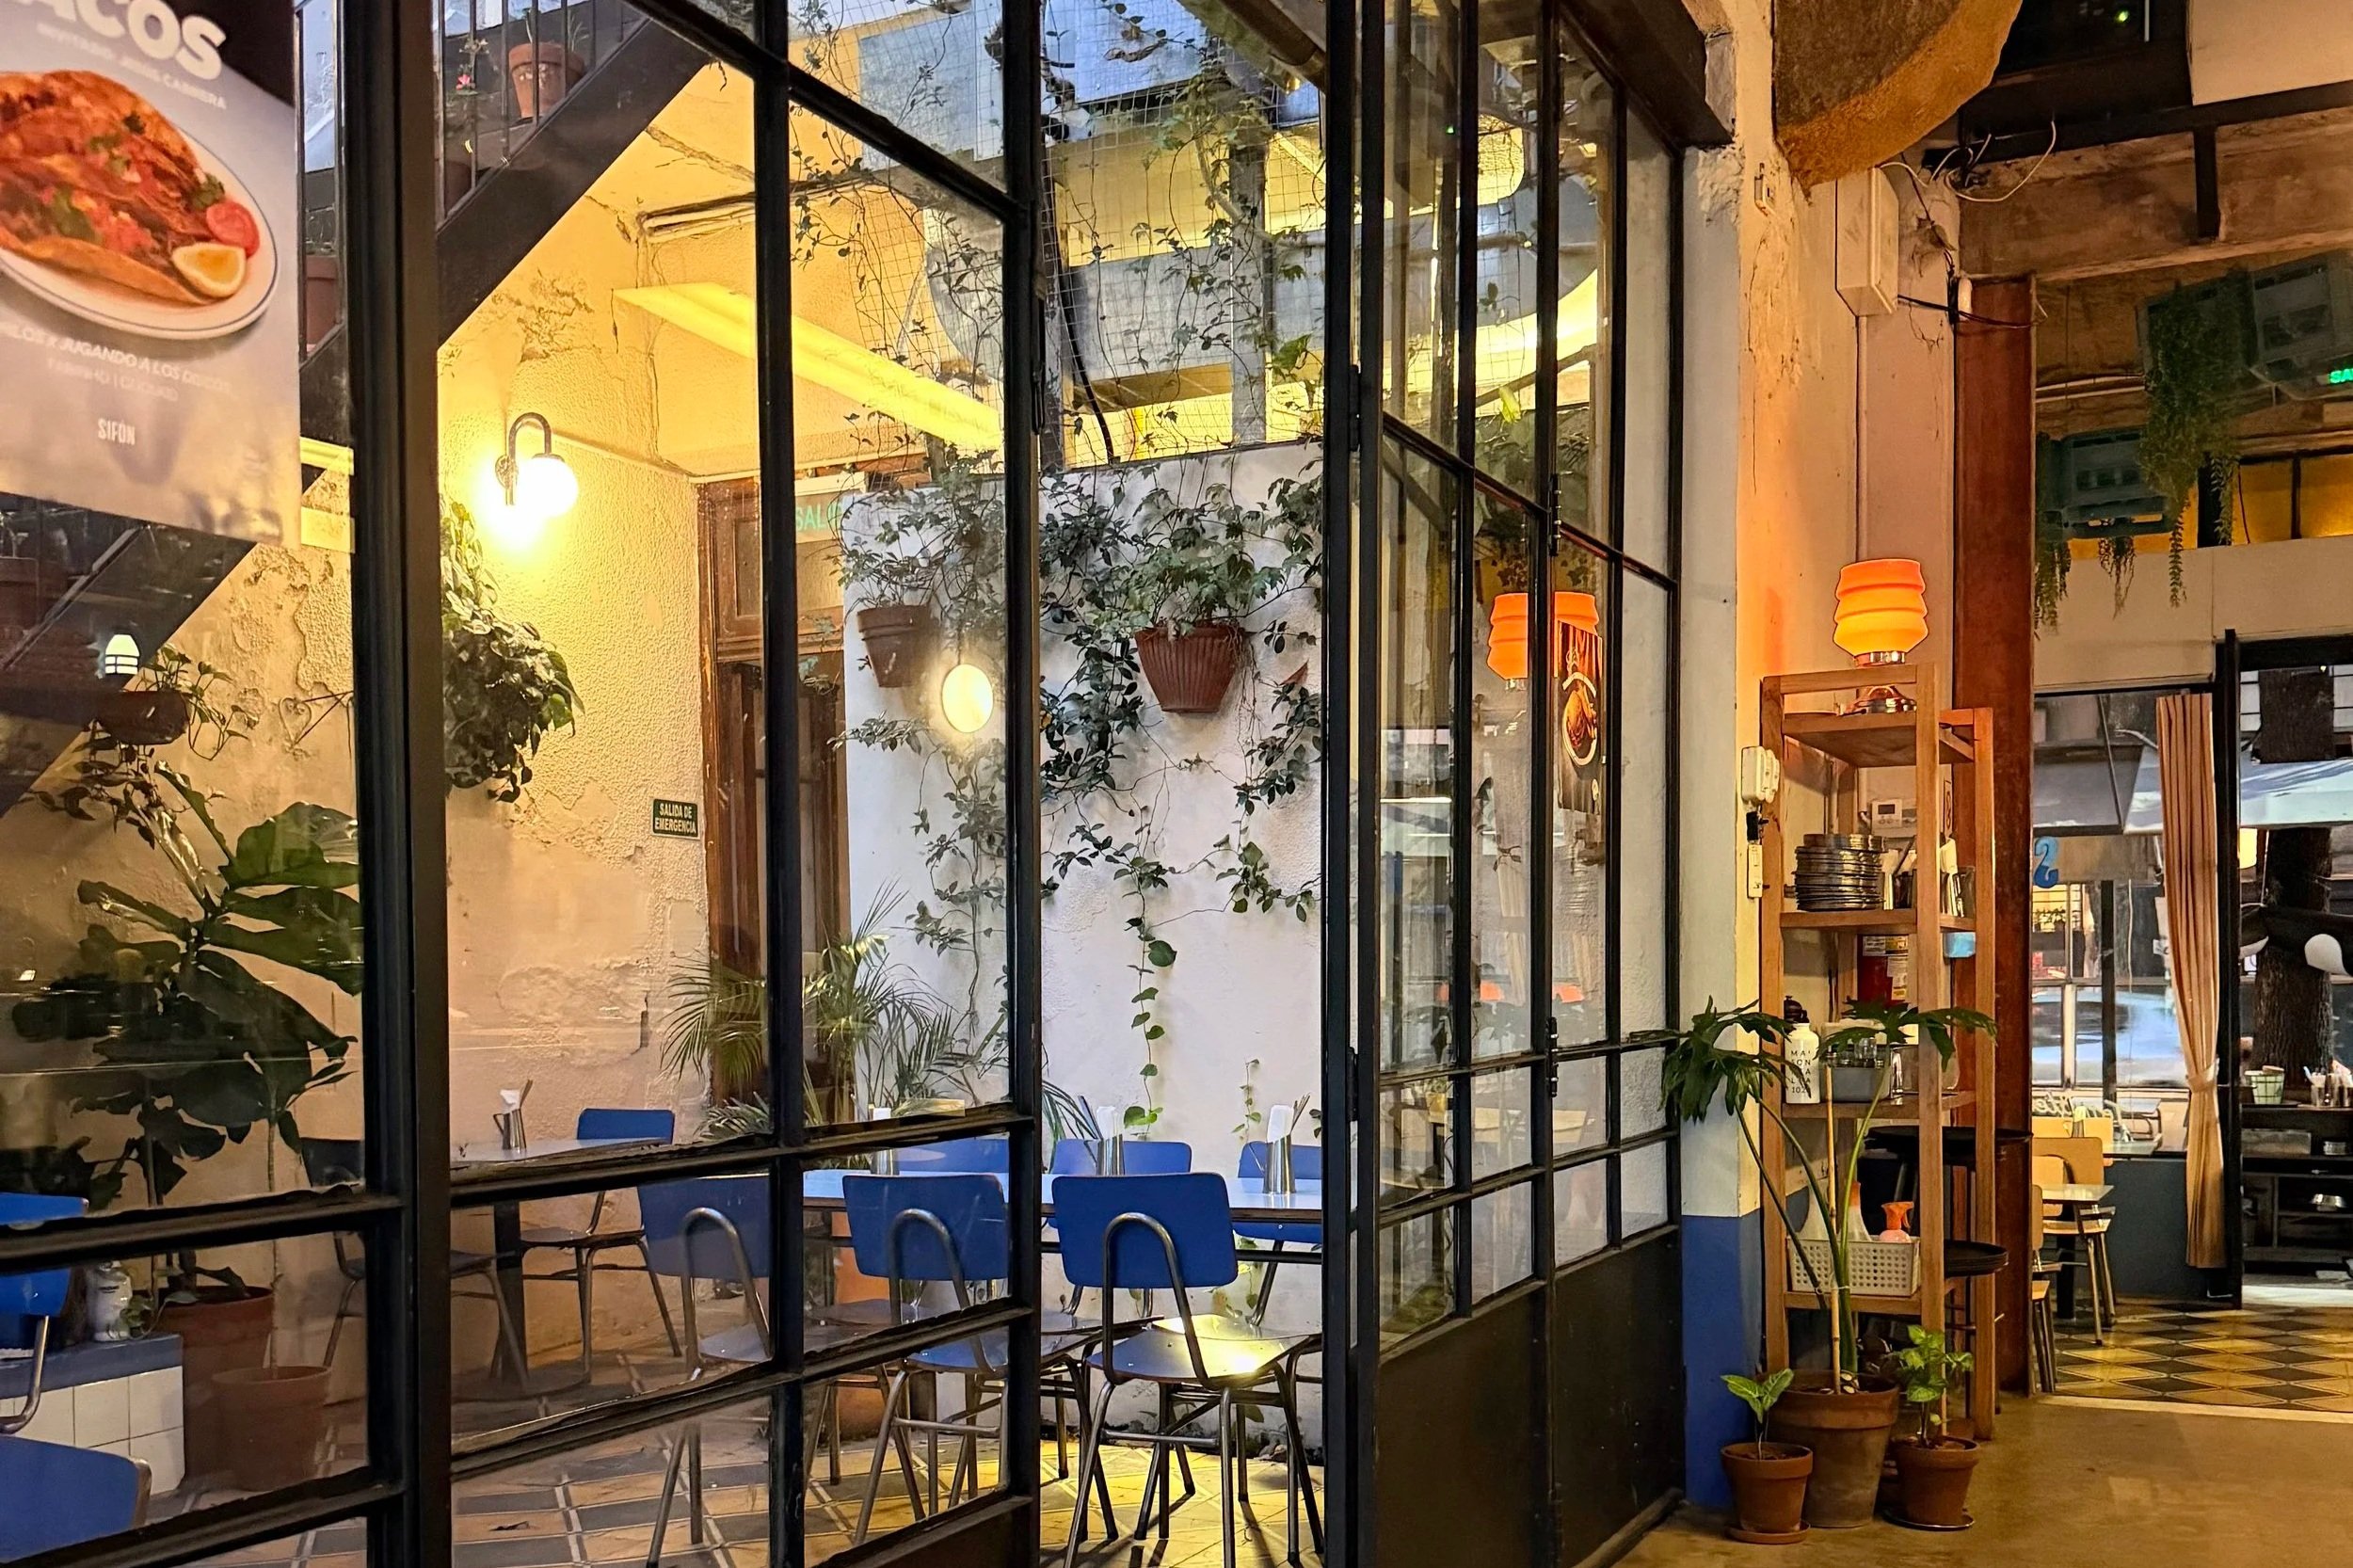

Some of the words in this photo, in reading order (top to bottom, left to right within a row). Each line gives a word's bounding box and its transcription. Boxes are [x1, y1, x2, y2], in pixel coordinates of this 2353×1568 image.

[19, 0, 226, 80] COS
[59, 337, 137, 368] JUGANDO
[152, 360, 179, 380] LOS
[655, 817, 696, 834] EMERGENCIA
[659, 803, 682, 818] SALIDA
[683, 805, 693, 820] DE
